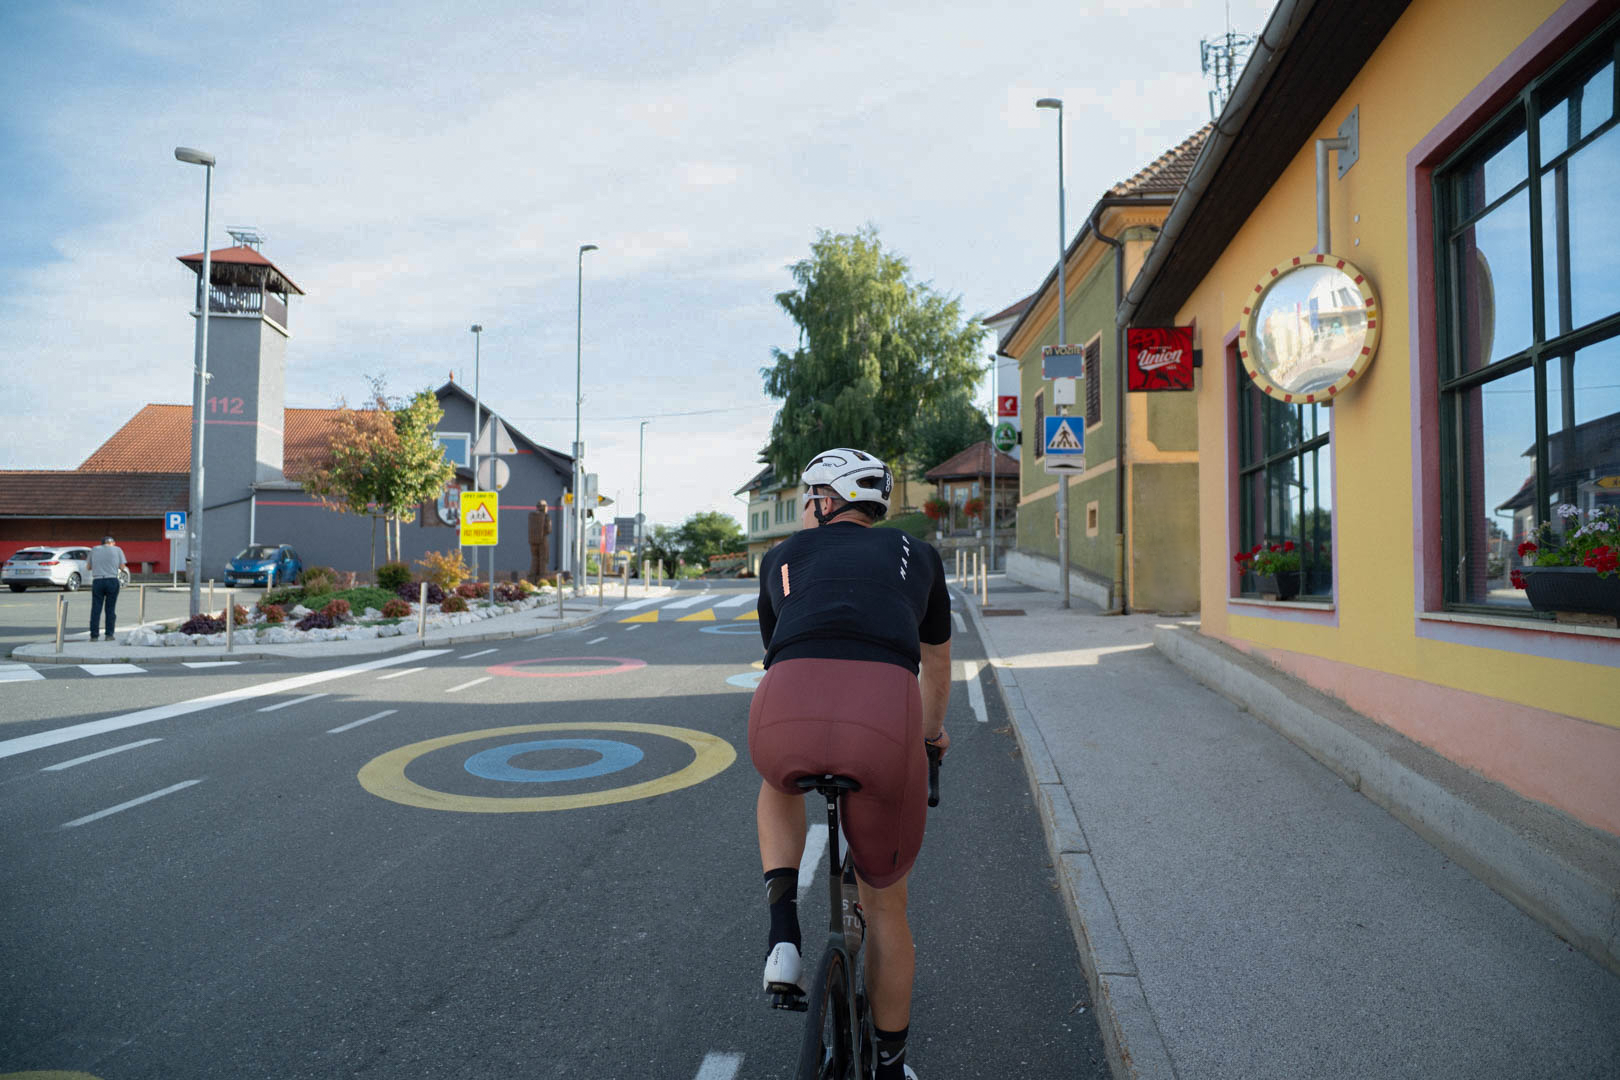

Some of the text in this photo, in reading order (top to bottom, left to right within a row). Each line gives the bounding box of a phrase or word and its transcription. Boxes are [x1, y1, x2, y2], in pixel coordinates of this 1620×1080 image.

[1137, 348, 1183, 367] Union
[207, 396, 244, 414] 112
[170, 514, 181, 528] P
